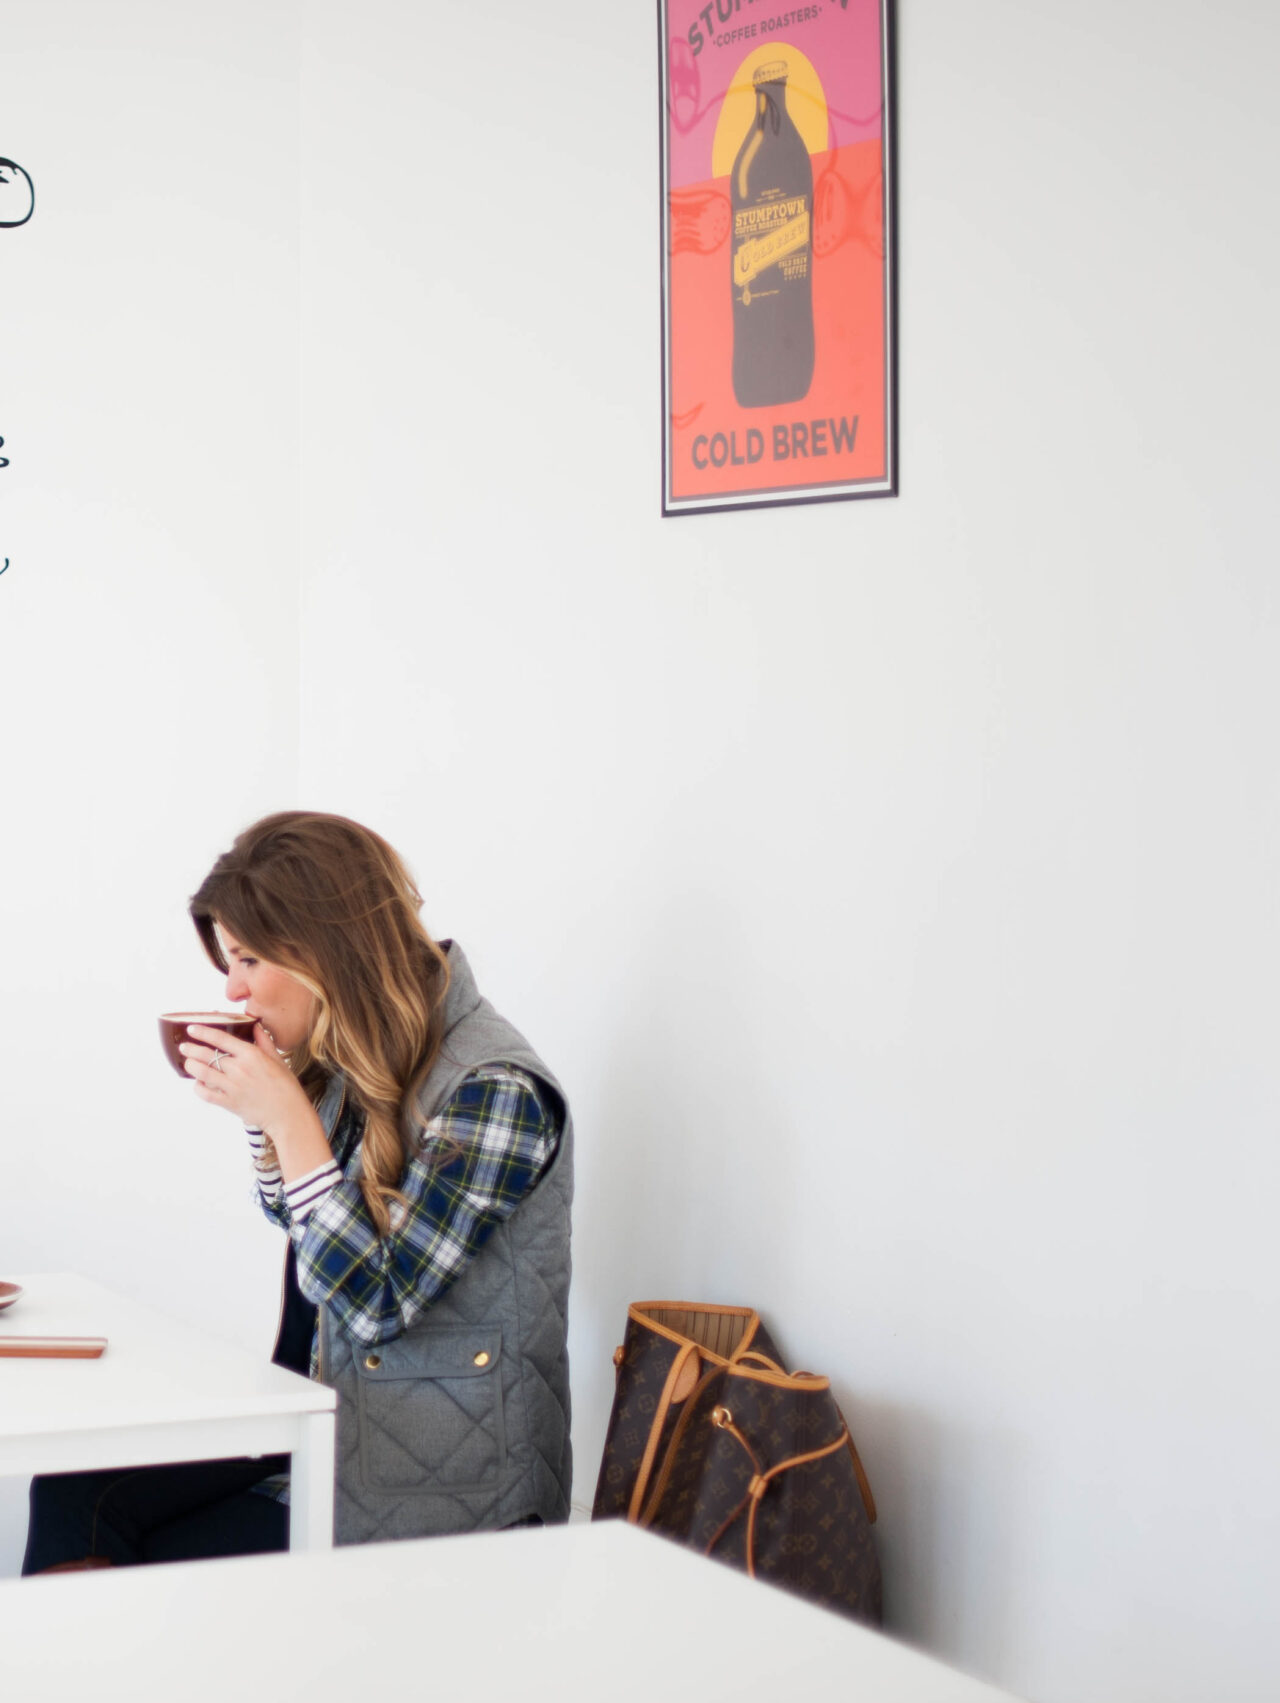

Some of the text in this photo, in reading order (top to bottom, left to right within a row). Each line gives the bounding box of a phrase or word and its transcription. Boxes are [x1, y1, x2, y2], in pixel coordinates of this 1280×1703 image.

[735, 199, 805, 227] STUMPTOWN
[691, 415, 859, 470] COLD BREW
